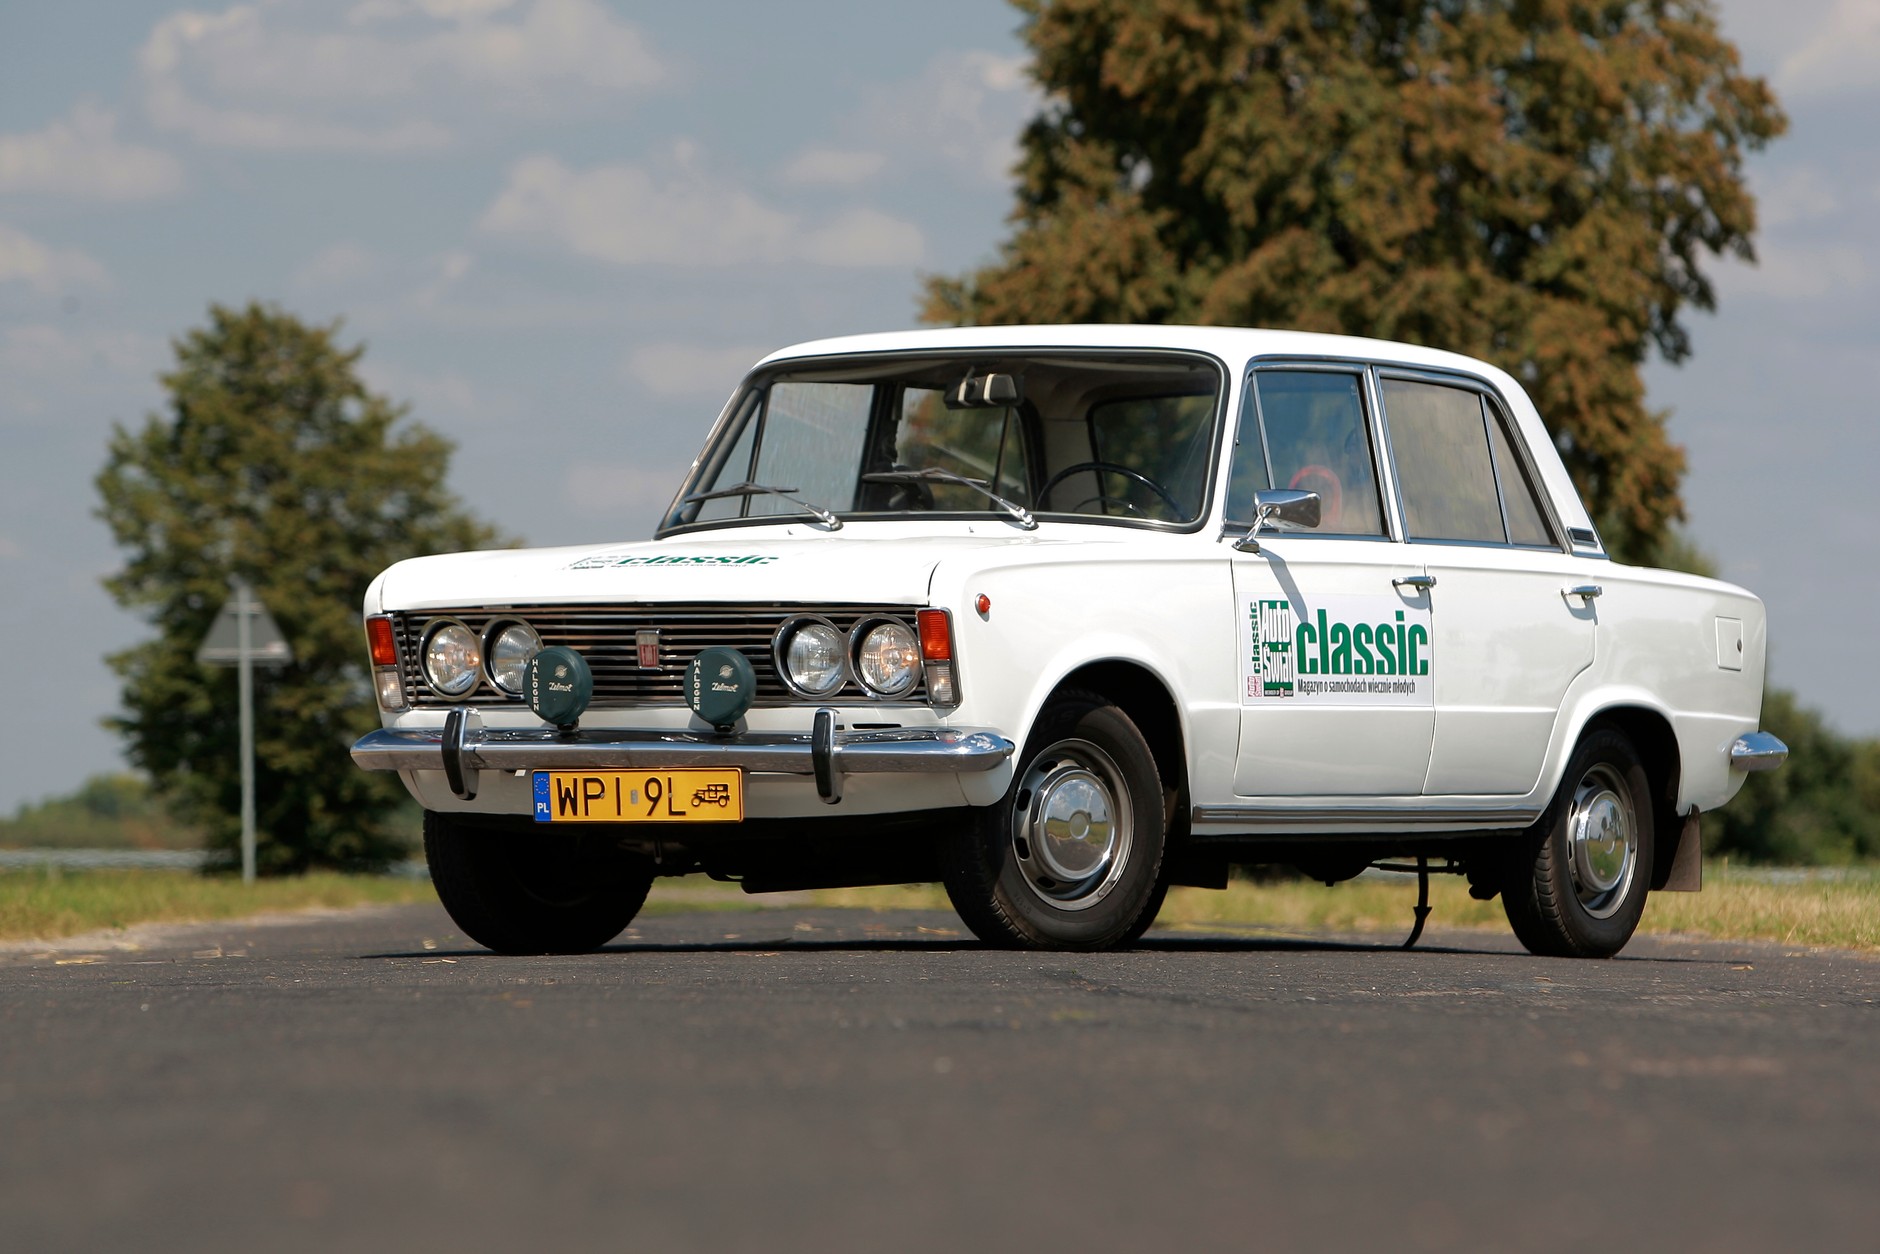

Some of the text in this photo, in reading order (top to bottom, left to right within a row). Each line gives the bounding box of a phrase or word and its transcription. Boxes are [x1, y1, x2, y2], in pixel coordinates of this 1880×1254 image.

[616, 555, 780, 565] classic
[1249, 602, 1261, 674] classic
[1262, 602, 1291, 643] Auto
[1296, 608, 1429, 675] classic
[532, 659, 540, 711] HALOGEN
[693, 659, 701, 711] HALOGEN
[1298, 678, 1323, 695] Magazyn
[1324, 680, 1328, 692] o
[1329, 678, 1367, 693] samochodach
[1368, 678, 1392, 694] wiecznie
[1392, 678, 1416, 696] młodych
[537, 802, 550, 813] PL
[556, 776, 686, 816] WPI 9L
